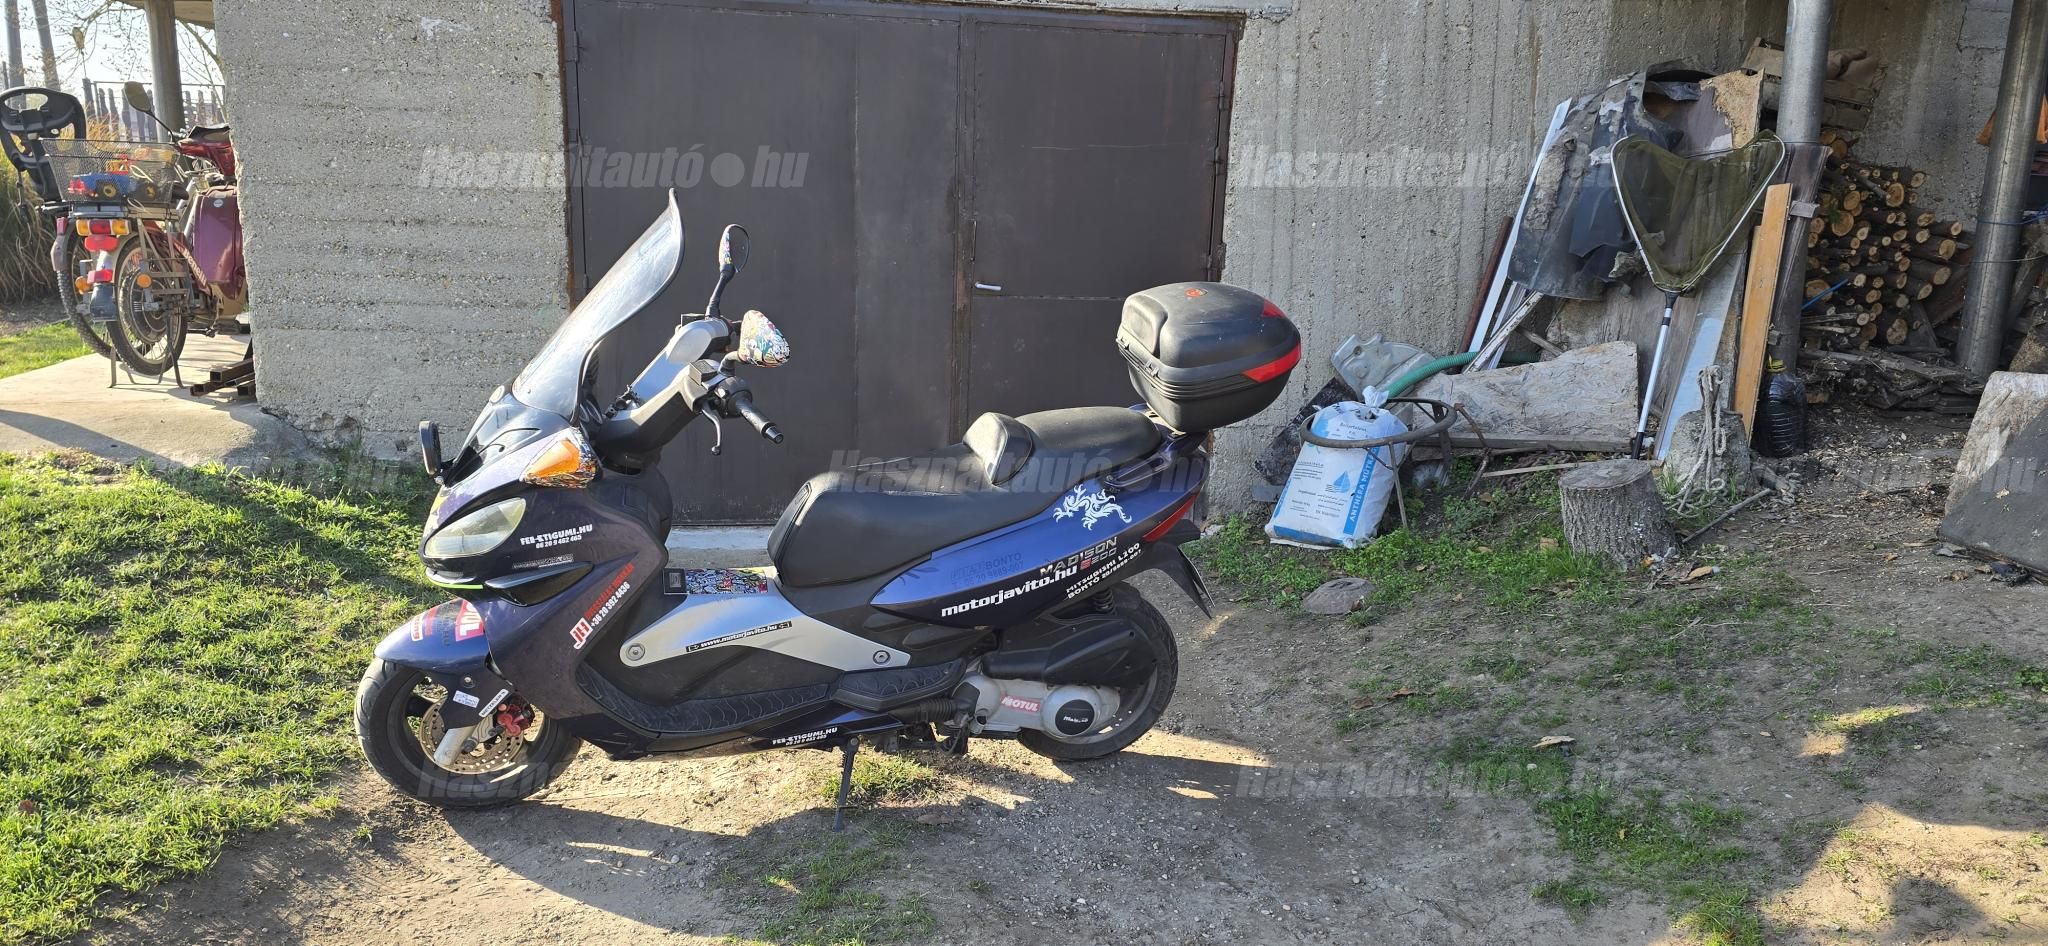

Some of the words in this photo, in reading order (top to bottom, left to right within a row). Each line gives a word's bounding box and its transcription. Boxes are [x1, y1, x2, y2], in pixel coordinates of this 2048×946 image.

[1040, 537, 1117, 575] MADISON
[1118, 543, 1140, 560] L200
[941, 565, 1078, 617] motorjavito.hu
[600, 606, 609, 618] 20
[1001, 696, 1039, 712] MOTUL
